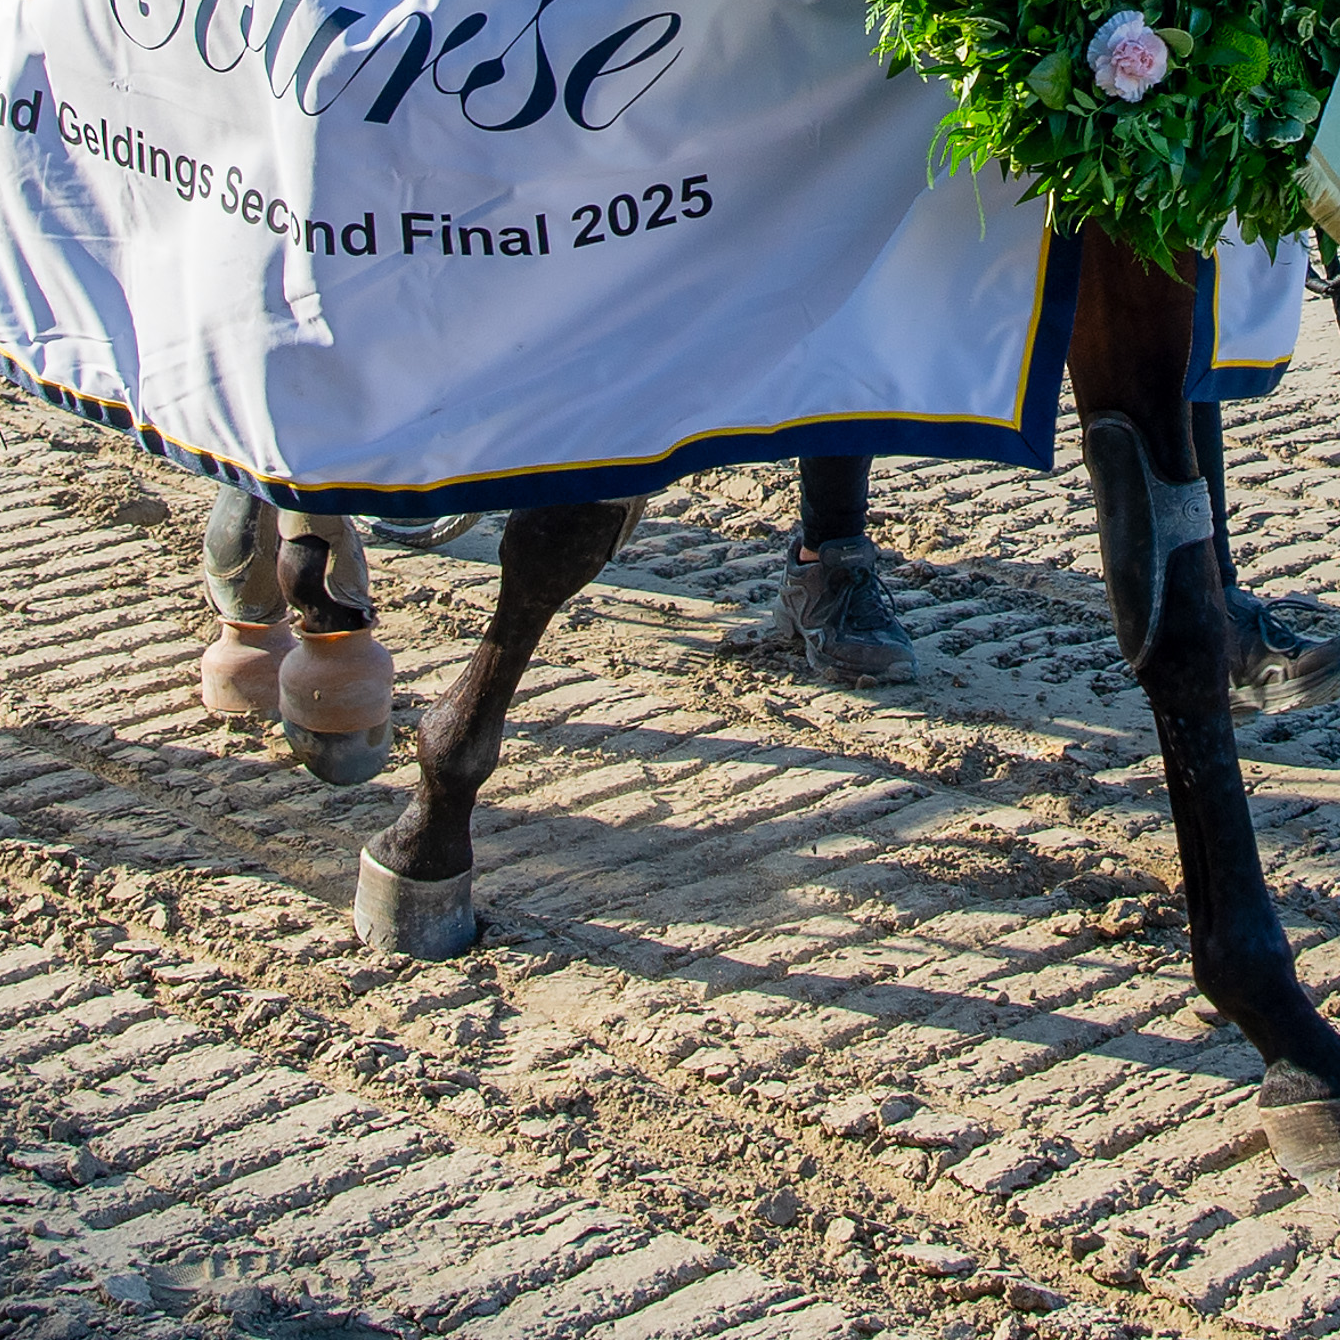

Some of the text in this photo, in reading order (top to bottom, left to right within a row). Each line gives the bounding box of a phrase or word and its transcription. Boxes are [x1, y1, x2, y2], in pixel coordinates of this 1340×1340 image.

[57, 101, 214, 202] Geldings
[220, 165, 377, 257] Second
[401, 211, 551, 258] Final
[570, 173, 714, 249] 2025
